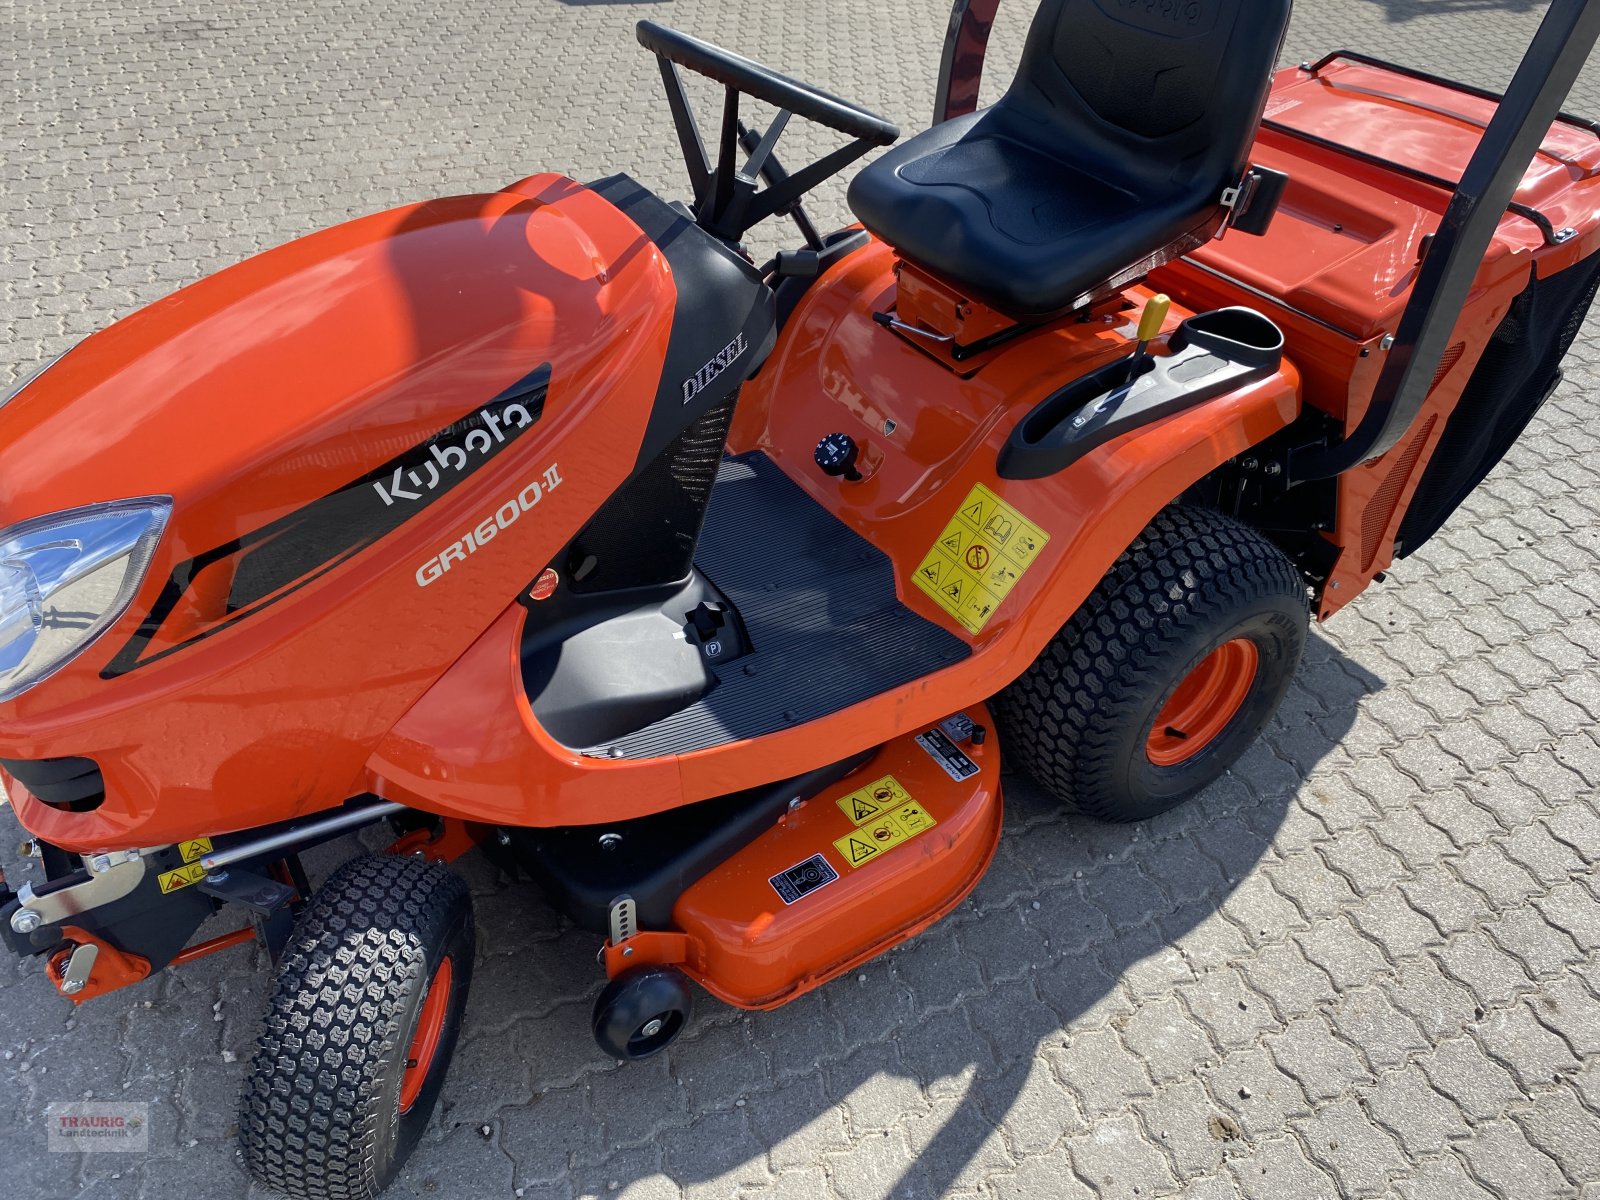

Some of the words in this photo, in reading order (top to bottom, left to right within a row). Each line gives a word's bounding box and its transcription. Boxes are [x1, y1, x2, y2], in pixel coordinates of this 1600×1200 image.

[682, 331, 748, 406] DIESEL
[373, 403, 533, 507] Kubota
[415, 463, 563, 587] GR1600-II
